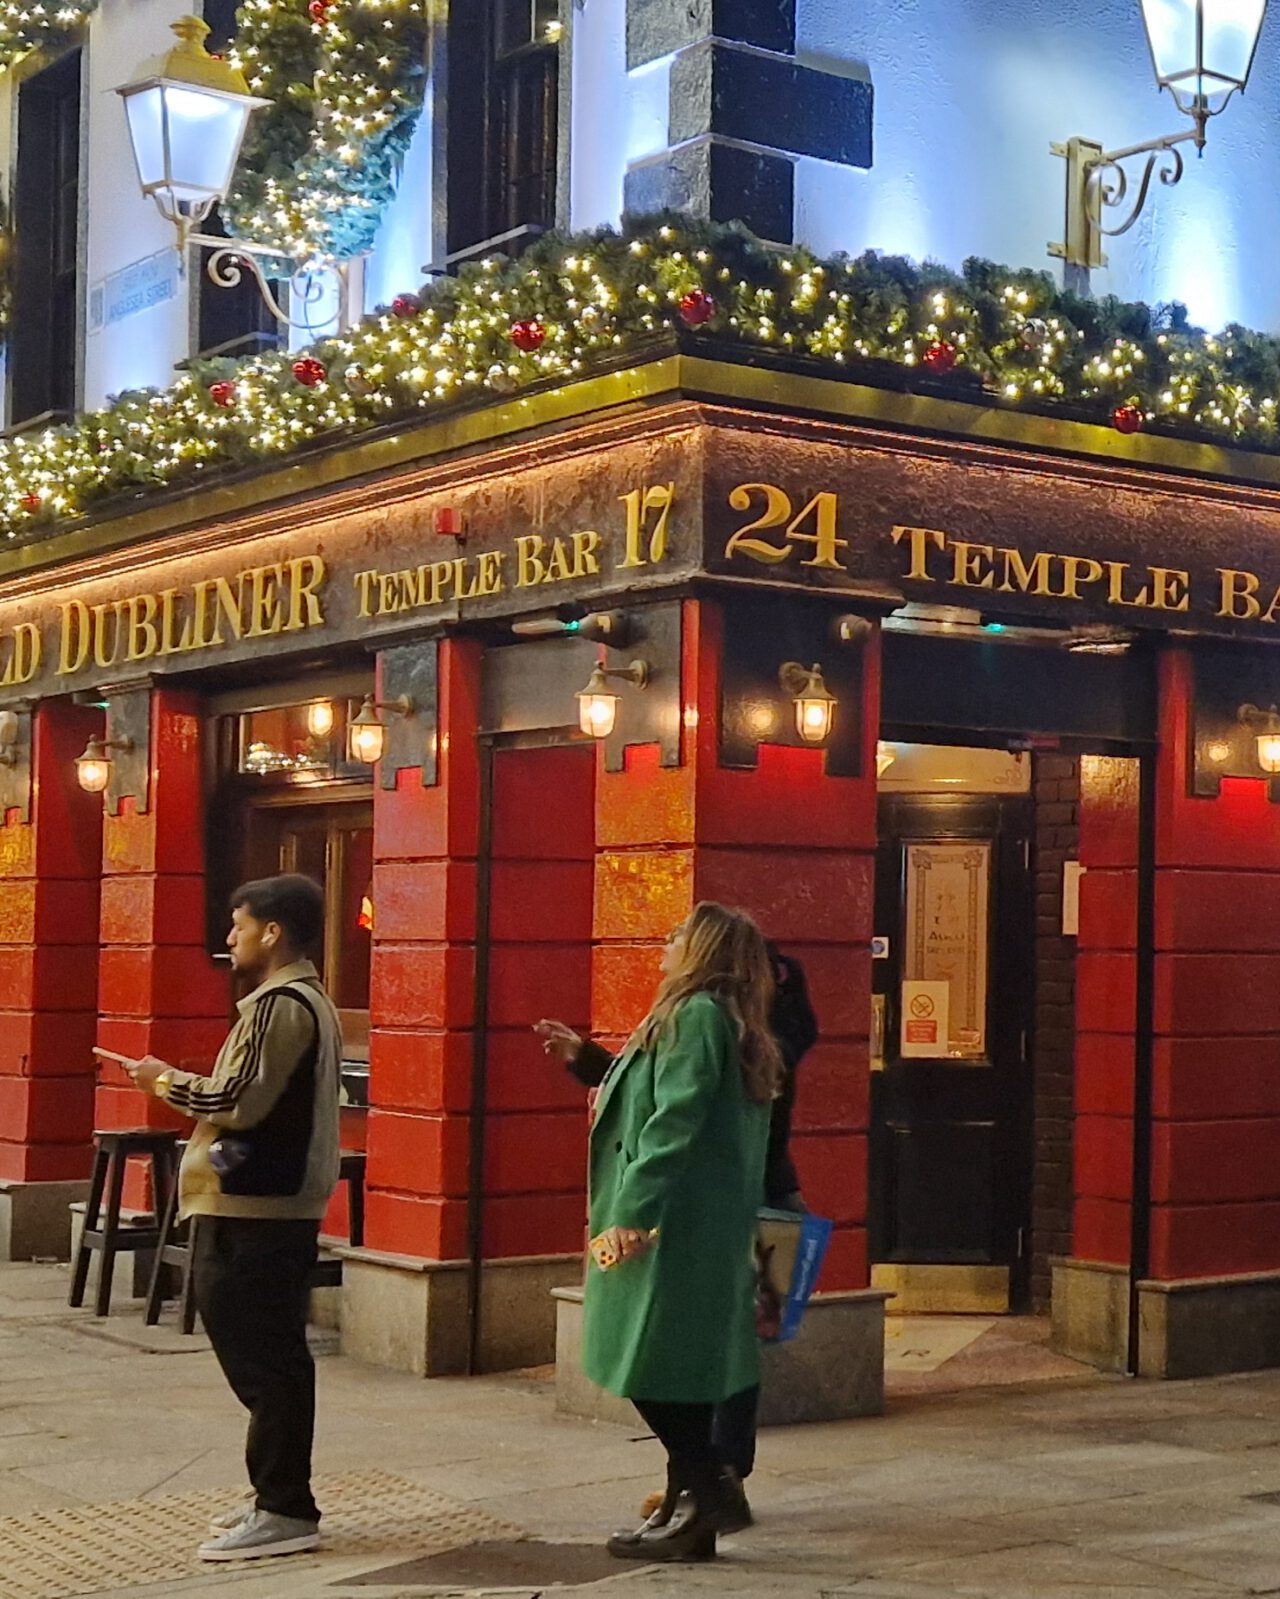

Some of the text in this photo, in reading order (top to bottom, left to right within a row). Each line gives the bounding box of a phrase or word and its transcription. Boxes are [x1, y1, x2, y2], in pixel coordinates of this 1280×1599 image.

[354, 481, 674, 618] TEMPLE BAR 17
[725, 483, 848, 570] 24
[890, 525, 1190, 611] TEMPLE
[54, 555, 325, 675] DUBLINER
